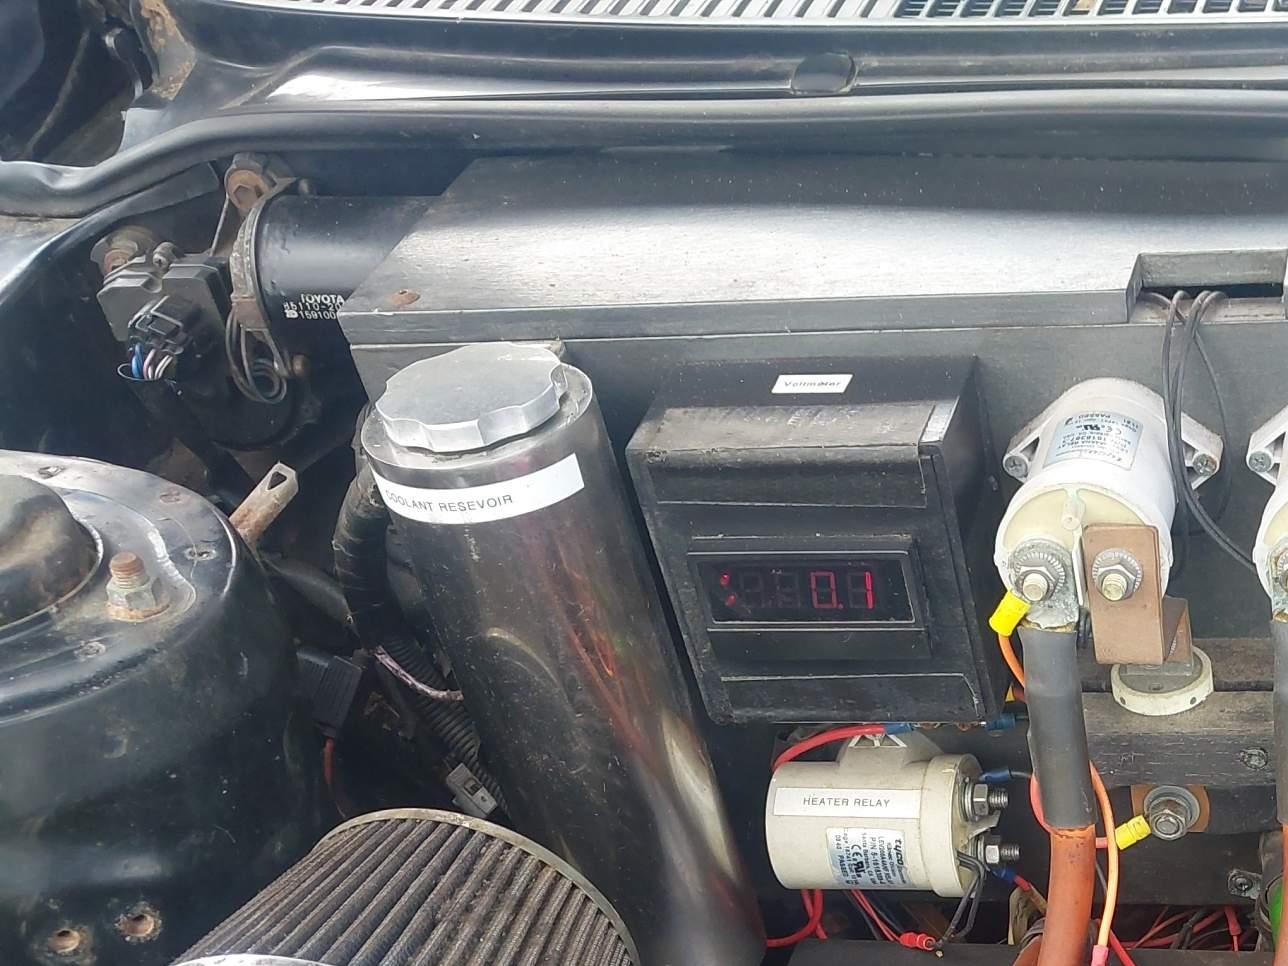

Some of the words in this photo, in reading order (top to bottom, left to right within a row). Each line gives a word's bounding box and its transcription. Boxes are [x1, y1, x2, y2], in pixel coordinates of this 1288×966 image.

[385, 489, 434, 512] COOLANT
[438, 494, 513, 512] RESEVOIR
[810, 570, 875, 609] 0.1
[803, 797, 849, 807] HEATER
[853, 798, 890, 808] RELAY
